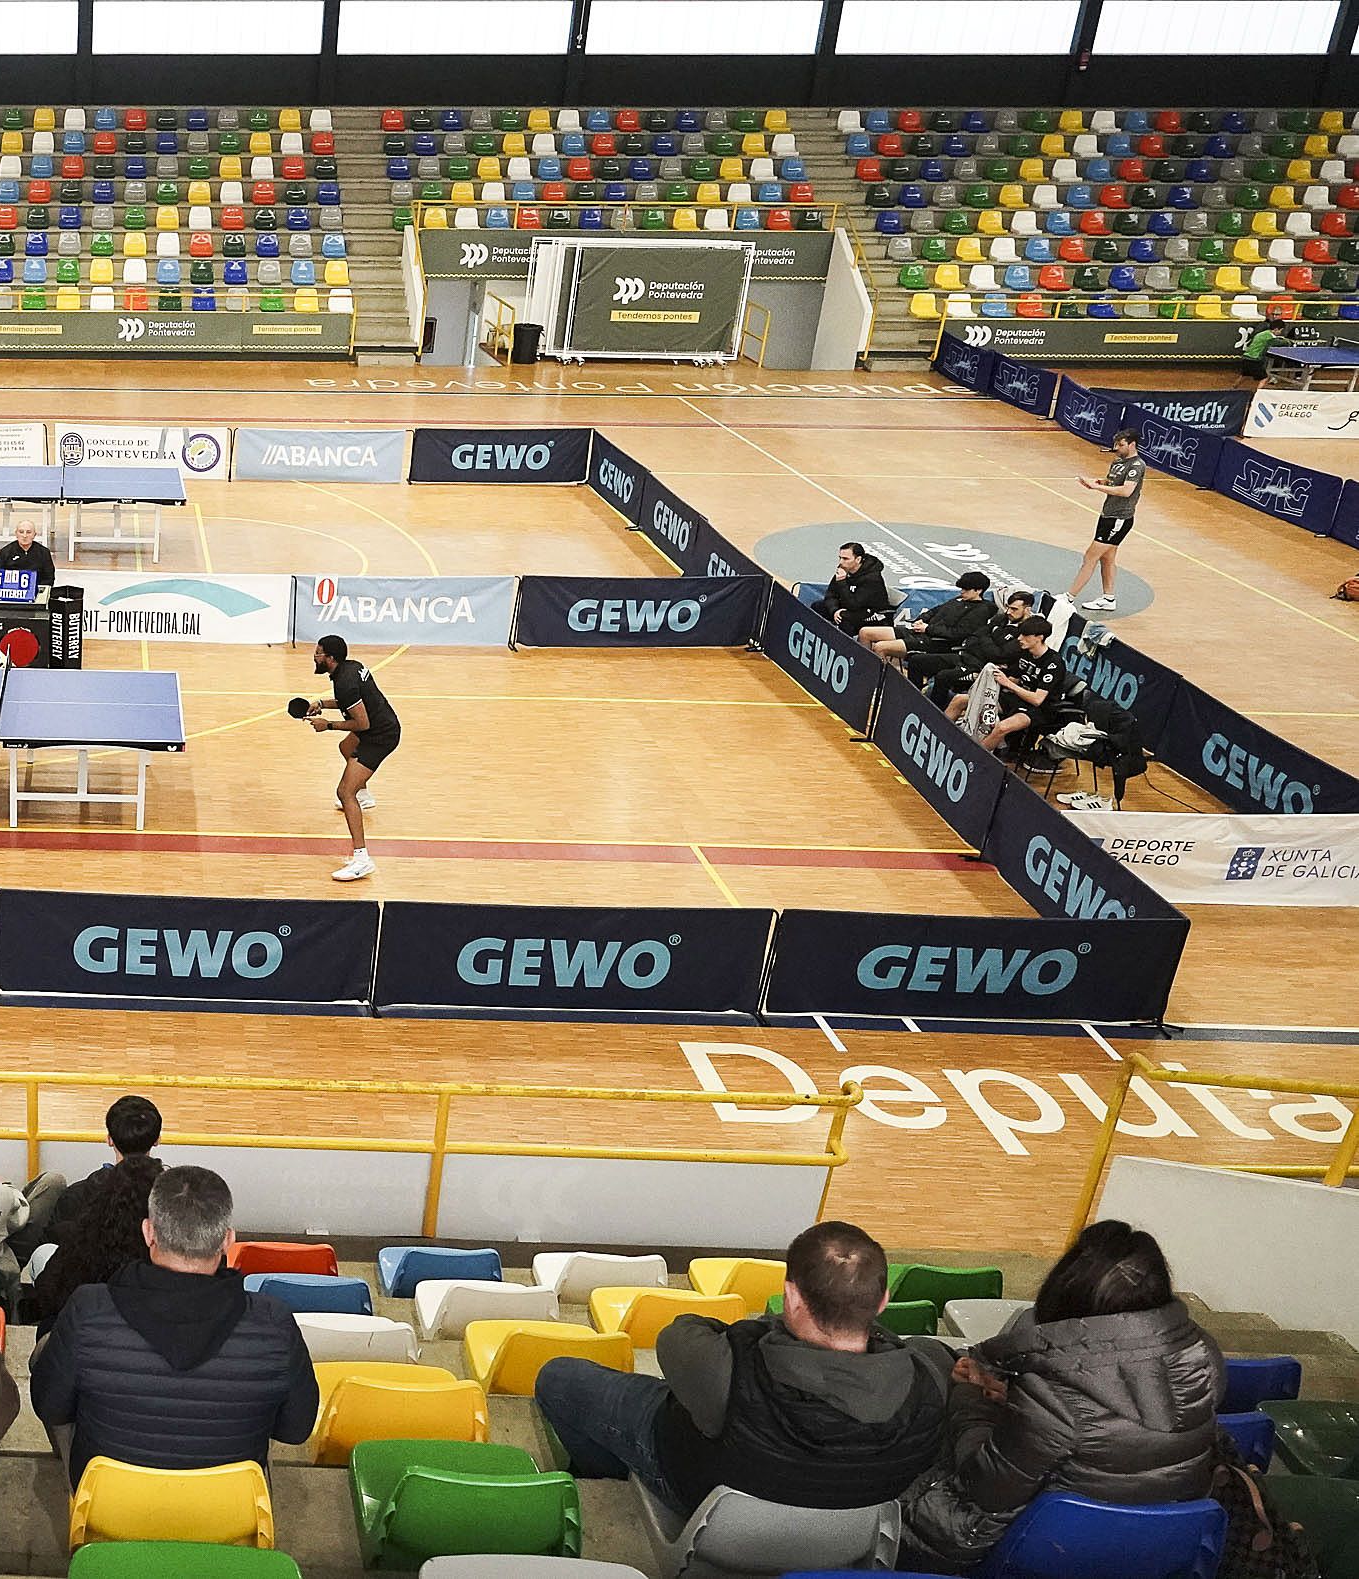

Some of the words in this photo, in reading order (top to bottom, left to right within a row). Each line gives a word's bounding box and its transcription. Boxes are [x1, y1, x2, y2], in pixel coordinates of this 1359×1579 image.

[649, 280, 705, 292] Deputación
[648, 289, 703, 300] Pontevedra
[617, 311, 661, 320] Tendemos
[663, 313, 693, 321] pontes
[148, 320, 195, 330] Deputación
[148, 328, 195, 337] Pontevedra
[996, 328, 1046, 339] Deputación
[994, 336, 1044, 345] Pontevedra
[1280, 403, 1319, 411] DEPORTE
[1278, 410, 1312, 418] GALEGO
[87, 438, 134, 446] CONCELLO
[21, 573, 30, 588] 6
[317, 578, 335, 605] 0
[51, 612, 63, 660] BUTTERFLY
[68, 612, 81, 660] BUTTERFLY
[1111, 838, 1196, 852] DEPORTE
[1268, 849, 1331, 862] XUNTA
[1262, 865, 1287, 878] DE
